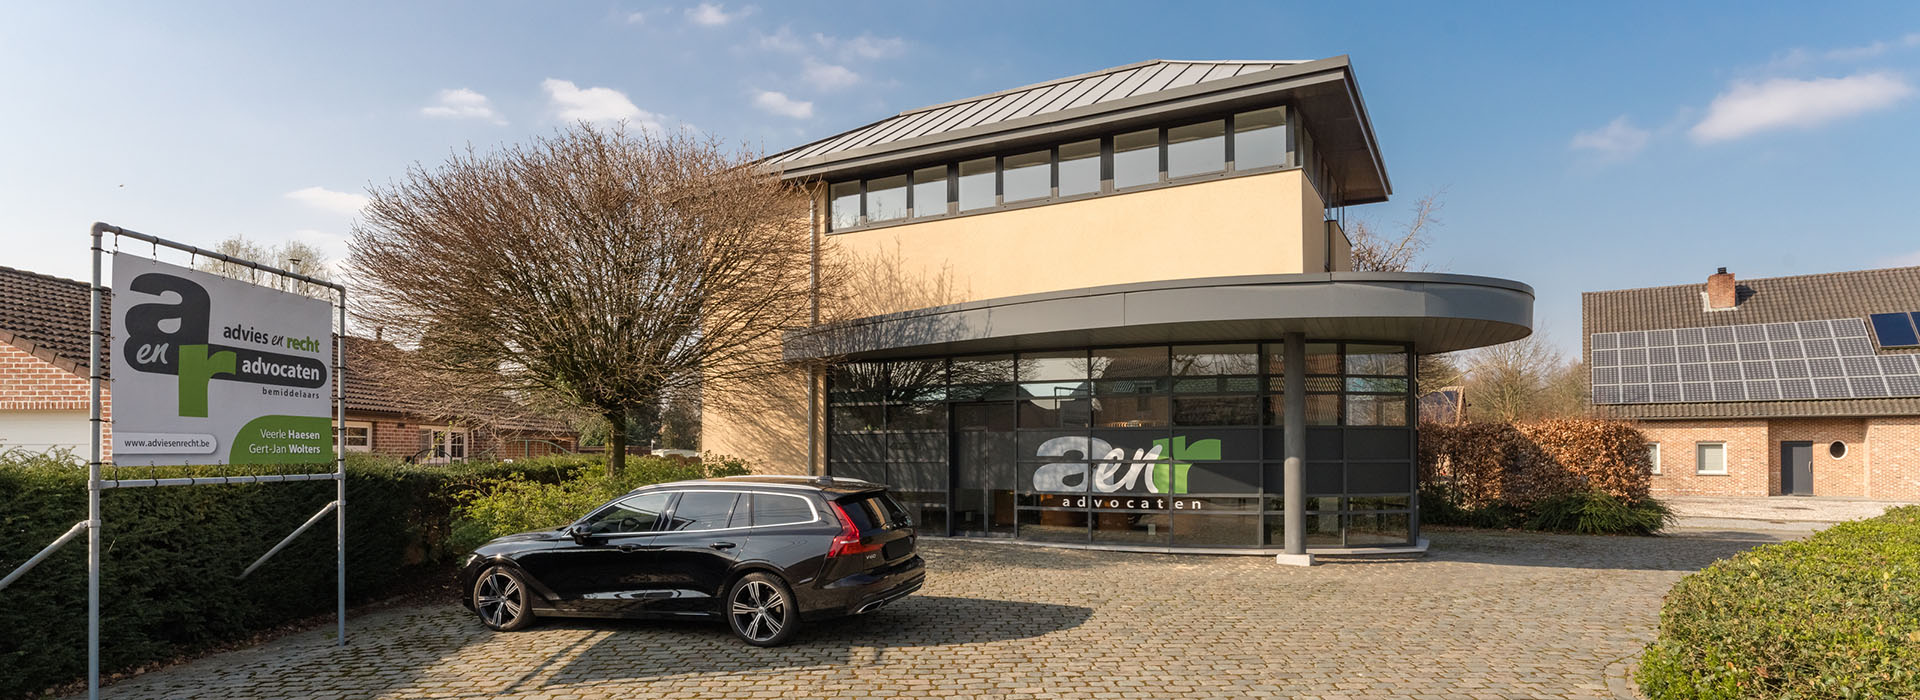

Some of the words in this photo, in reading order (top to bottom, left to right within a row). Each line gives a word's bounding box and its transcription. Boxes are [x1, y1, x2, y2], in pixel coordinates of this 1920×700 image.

[223, 324, 269, 345] advies
[271, 335, 284, 347] en
[286, 336, 320, 353] recht
[136, 342, 169, 365] en
[242, 357, 320, 381] advocaten
[262, 387, 320, 399] bemiddelaars
[260, 429, 287, 439] Veerle
[288, 430, 320, 440] Haesen
[124, 439, 210, 449] www.adviesenrecht.be
[249, 443, 287, 454] Gert-Jan
[289, 444, 321, 454] Wolters
[1062, 497, 1202, 510] advocaten
